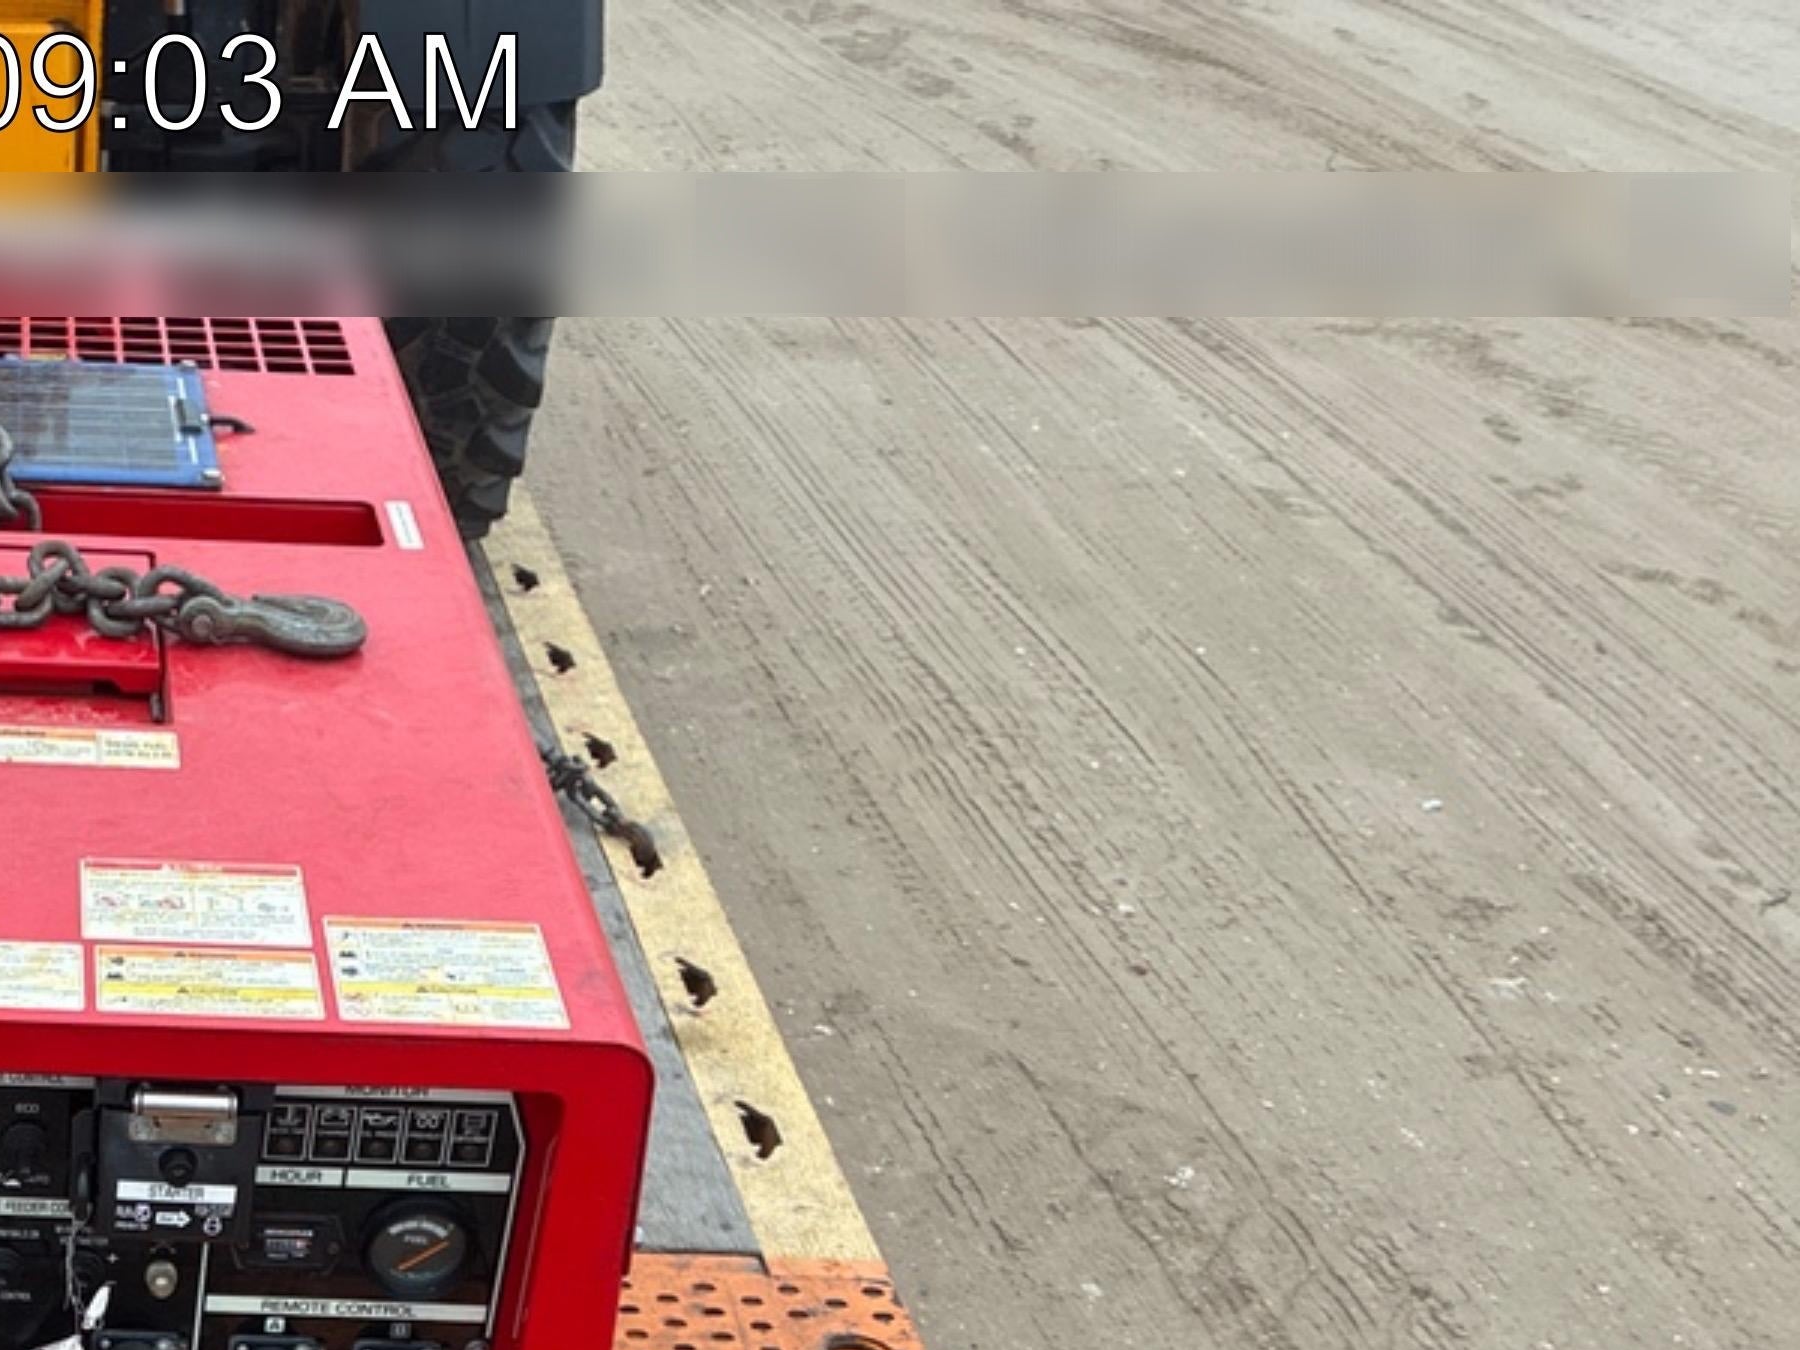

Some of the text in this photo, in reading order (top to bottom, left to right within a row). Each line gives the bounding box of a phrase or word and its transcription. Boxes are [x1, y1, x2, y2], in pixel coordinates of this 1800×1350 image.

[269, 1169, 321, 1182] HOUR
[407, 1176, 450, 1188] FUEL
[261, 1300, 415, 1317] REMOTE CONTROL
[269, 1319, 281, 1331] A
